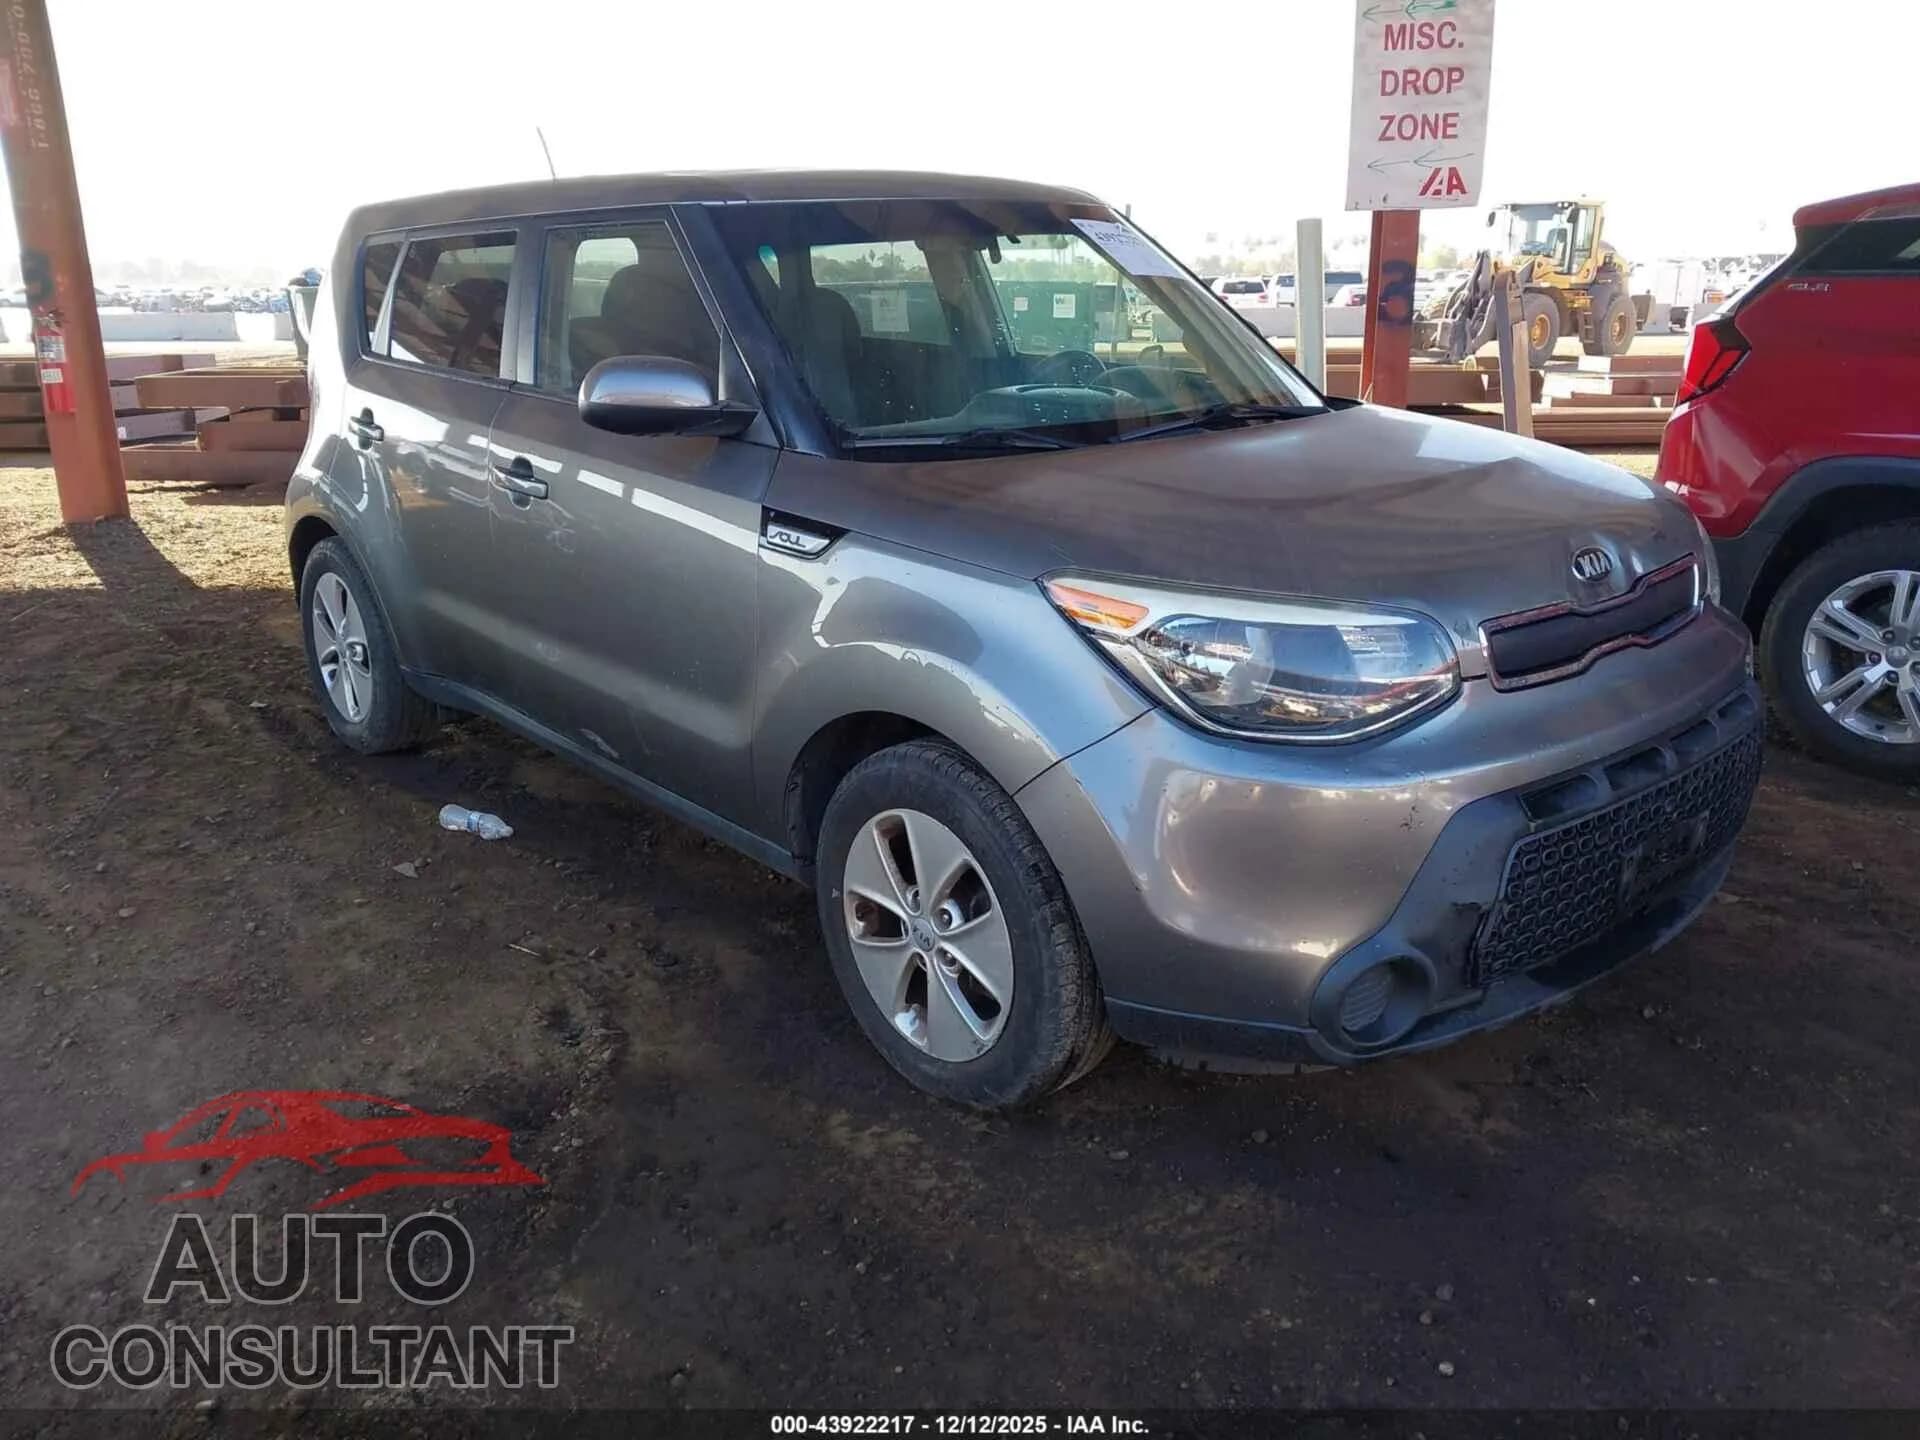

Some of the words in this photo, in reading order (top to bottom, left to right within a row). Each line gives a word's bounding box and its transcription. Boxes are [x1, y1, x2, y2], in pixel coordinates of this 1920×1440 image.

[1383, 21, 1464, 51] MISC.
[1380, 67, 1465, 97] DROP
[1378, 112, 1460, 141] ZONE
[1577, 551, 1611, 578] KIA
